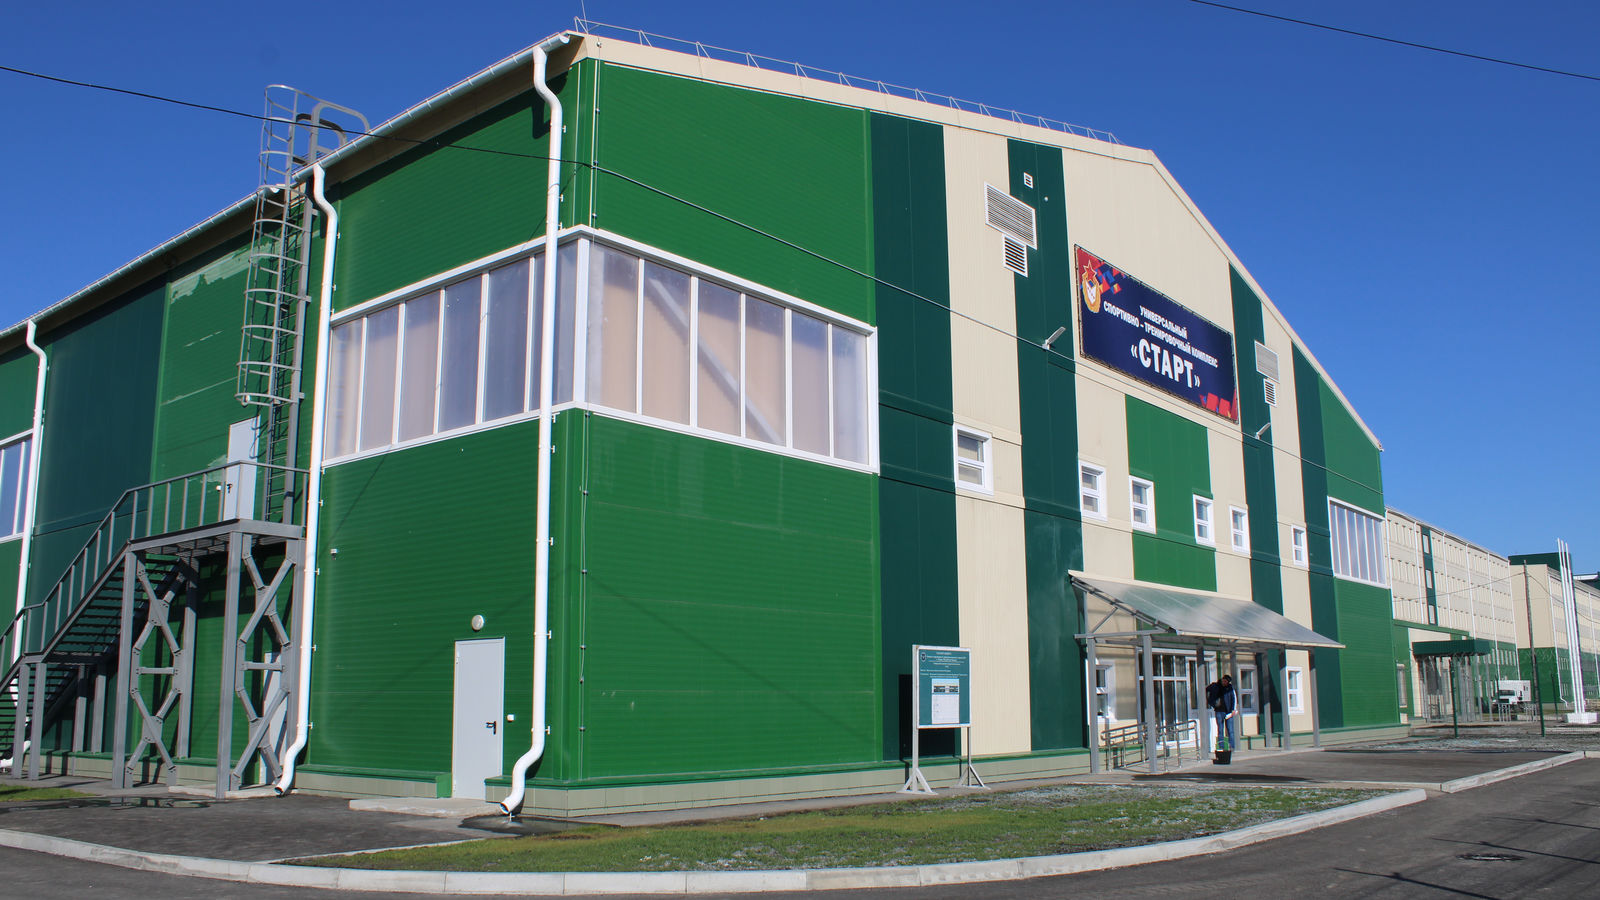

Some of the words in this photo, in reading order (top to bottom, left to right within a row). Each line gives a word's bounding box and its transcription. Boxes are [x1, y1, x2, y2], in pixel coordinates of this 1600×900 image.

[1103, 300, 1140, 328] СПОРТИВНО
[1144, 321, 1192, 355] ТРЕНИРОВОЧНЫЙ
[1191, 346, 1219, 368] КОМПЛЕКС
[1140, 305, 1188, 340] УНИВЕРСАЛЬНЫЙ
[1130, 338, 1201, 389] «СТАРТ»
